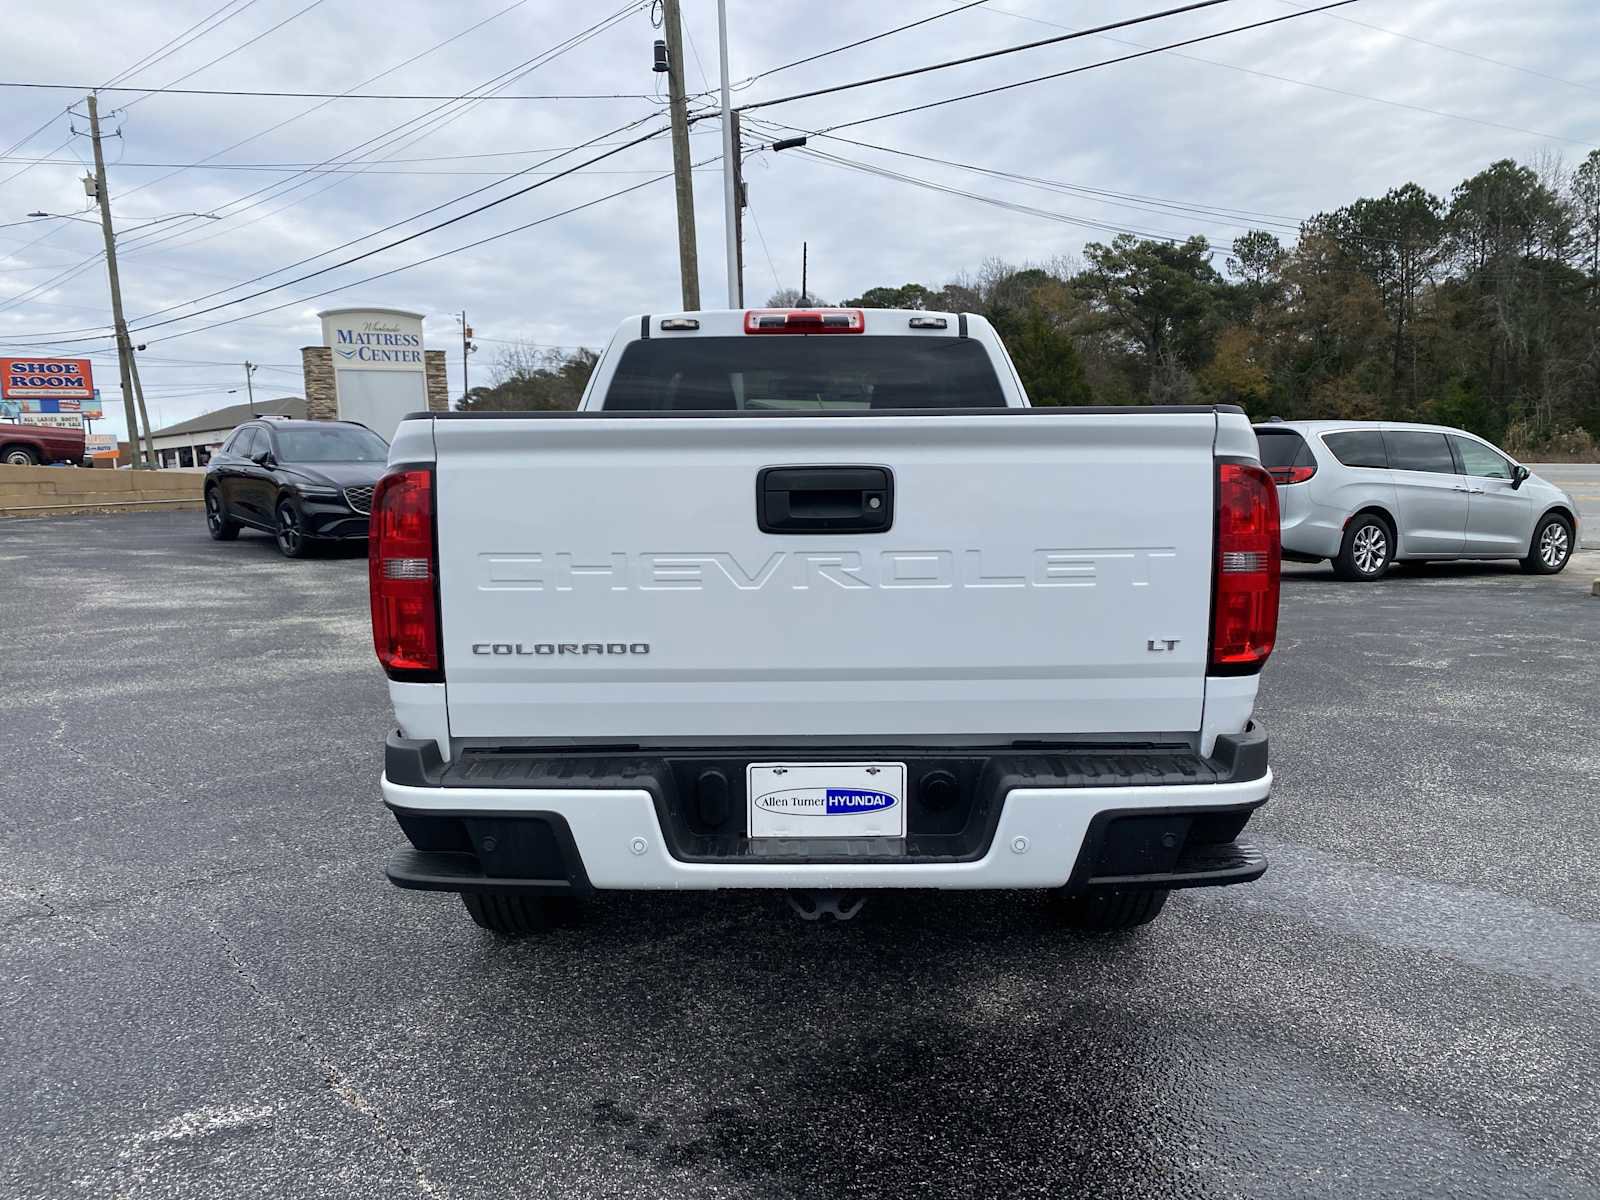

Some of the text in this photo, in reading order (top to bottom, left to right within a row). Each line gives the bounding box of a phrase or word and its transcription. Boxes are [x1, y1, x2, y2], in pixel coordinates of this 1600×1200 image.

[336, 329, 420, 346] MATTRESS
[358, 346, 422, 362] CENTER
[10, 362, 80, 374] SHOE
[9, 376, 84, 387] ROOM
[477, 547, 1177, 591] CHEVROLET
[471, 643, 651, 656] COLORADO
[1147, 639, 1181, 652] LT
[762, 795, 886, 807] Allen Turner HYUNDAI
